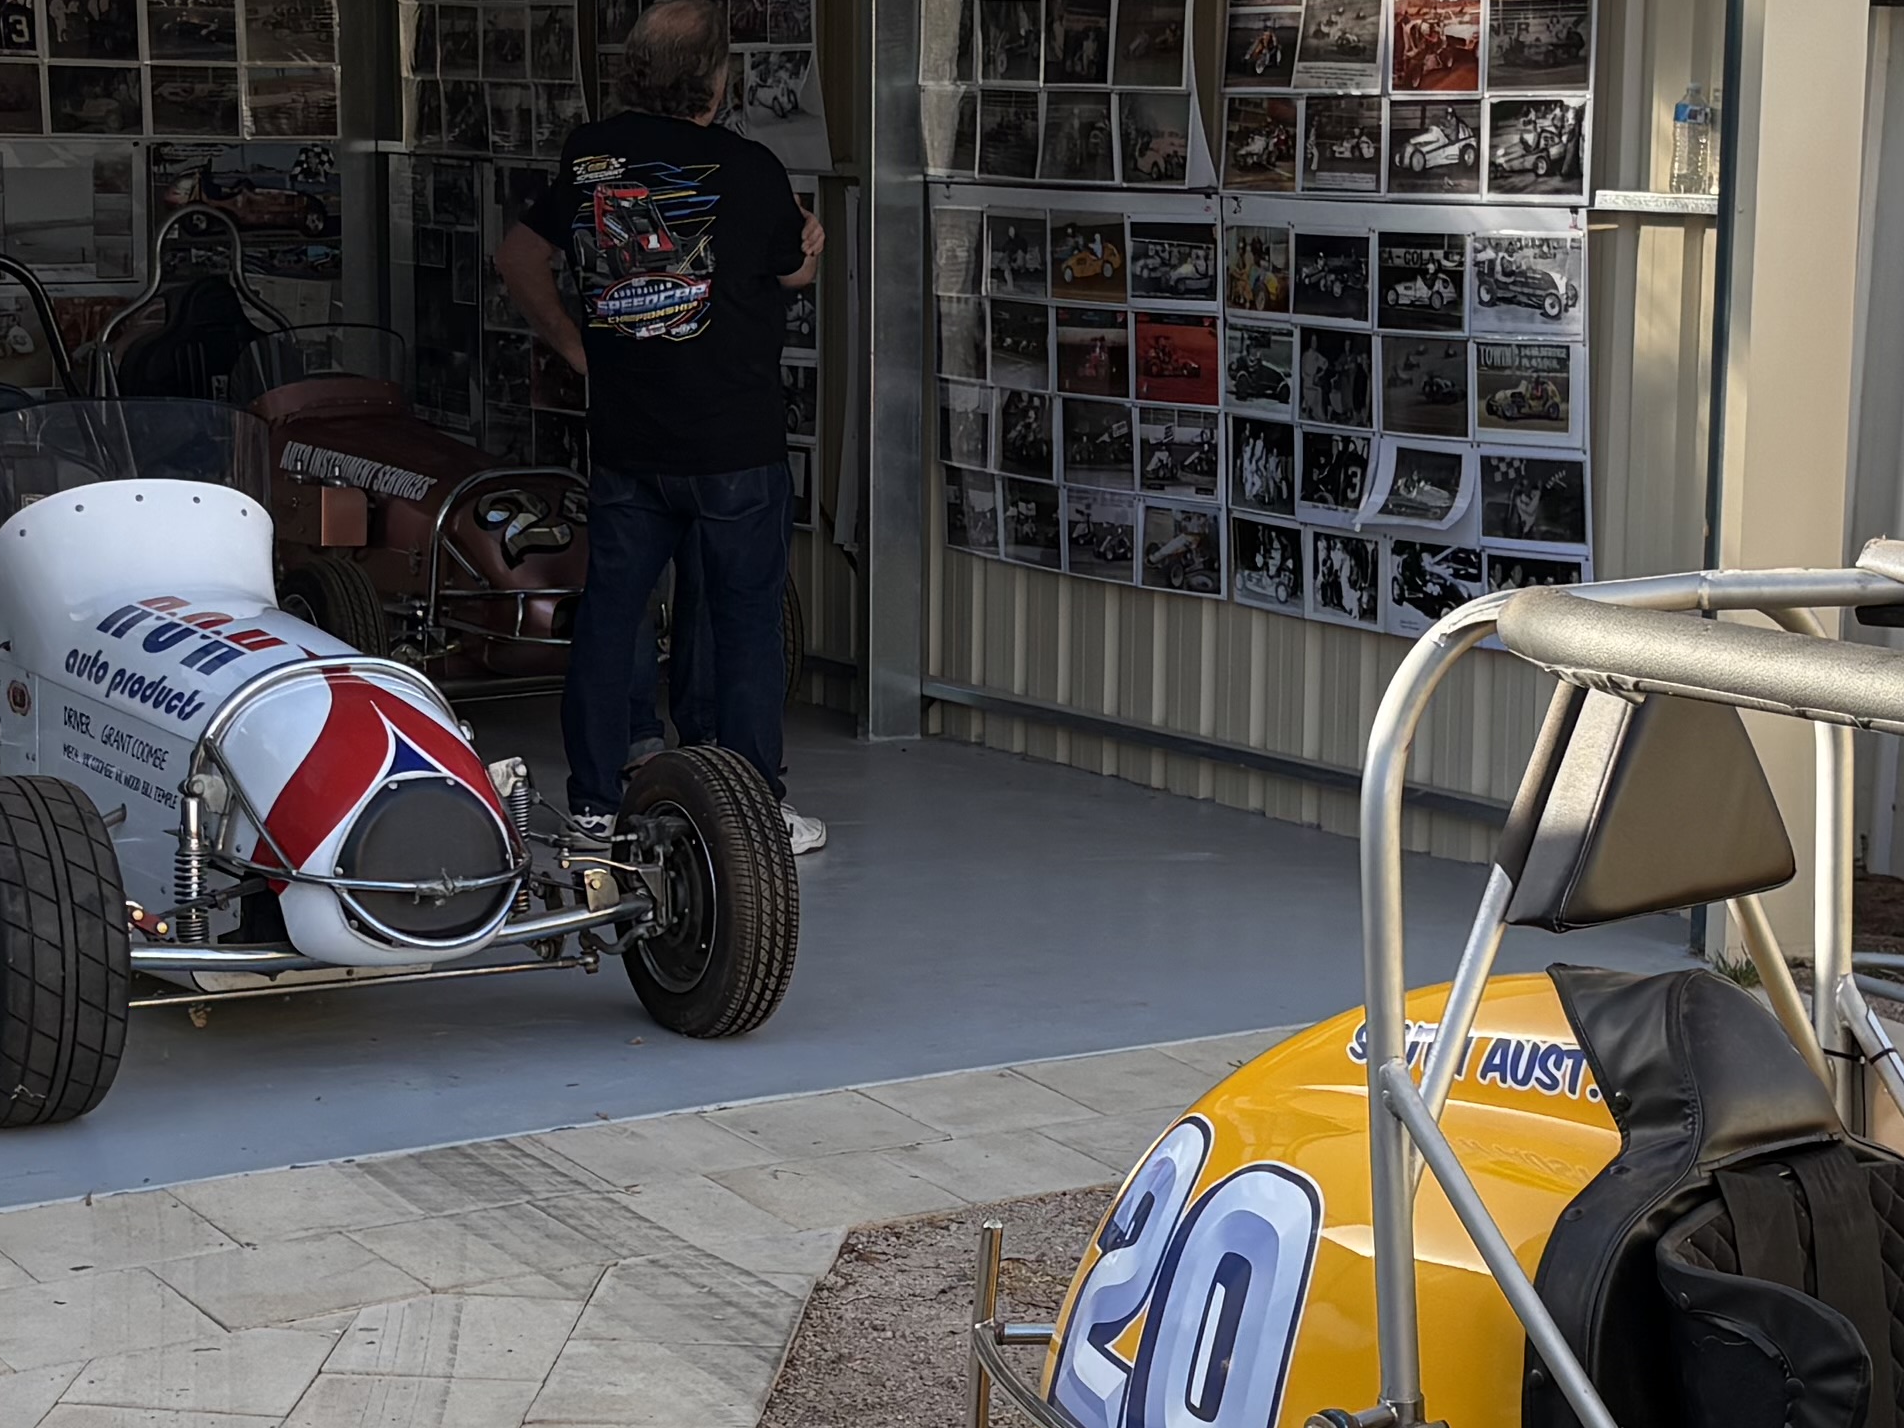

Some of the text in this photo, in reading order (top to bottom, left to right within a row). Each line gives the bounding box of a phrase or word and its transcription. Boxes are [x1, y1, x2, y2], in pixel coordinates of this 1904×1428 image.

[648, 234, 660, 250] 1
[64, 648, 206, 721] auto products
[1476, 1036, 1604, 1103] AUST.
